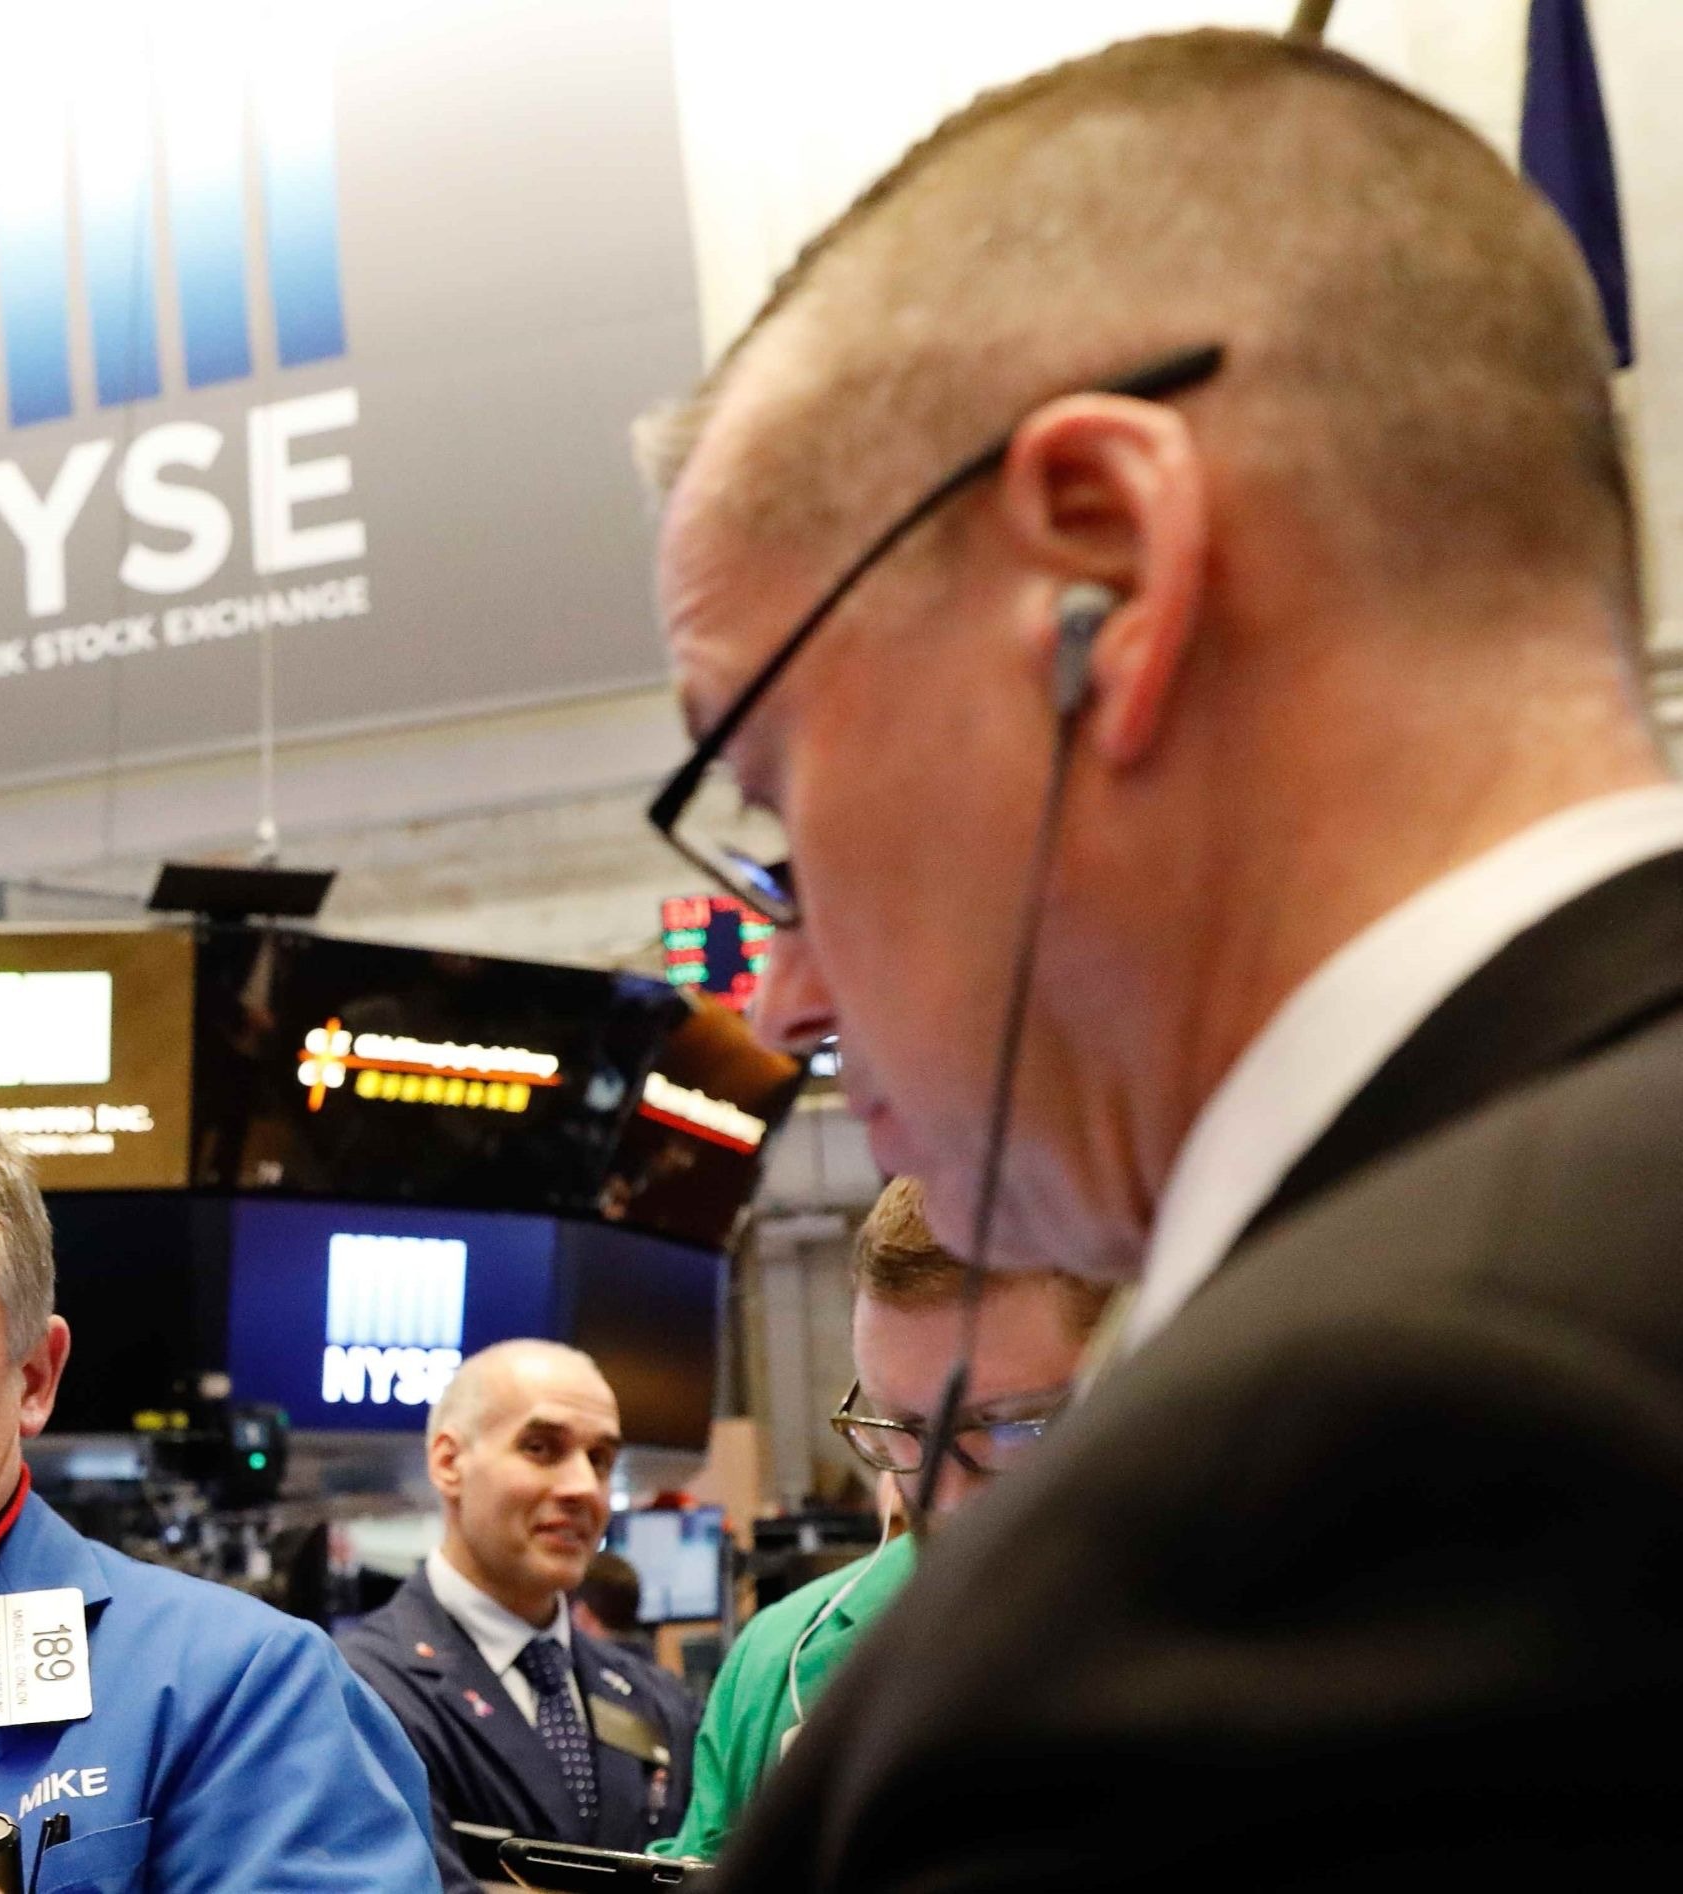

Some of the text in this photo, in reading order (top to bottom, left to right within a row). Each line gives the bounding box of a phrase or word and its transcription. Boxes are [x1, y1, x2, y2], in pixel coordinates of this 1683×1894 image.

[31, 611, 159, 671] STOCK
[161, 574, 371, 647] EXCHANGE
[32, 1624, 76, 1682] 189
[17, 1767, 108, 1820] MIKE
